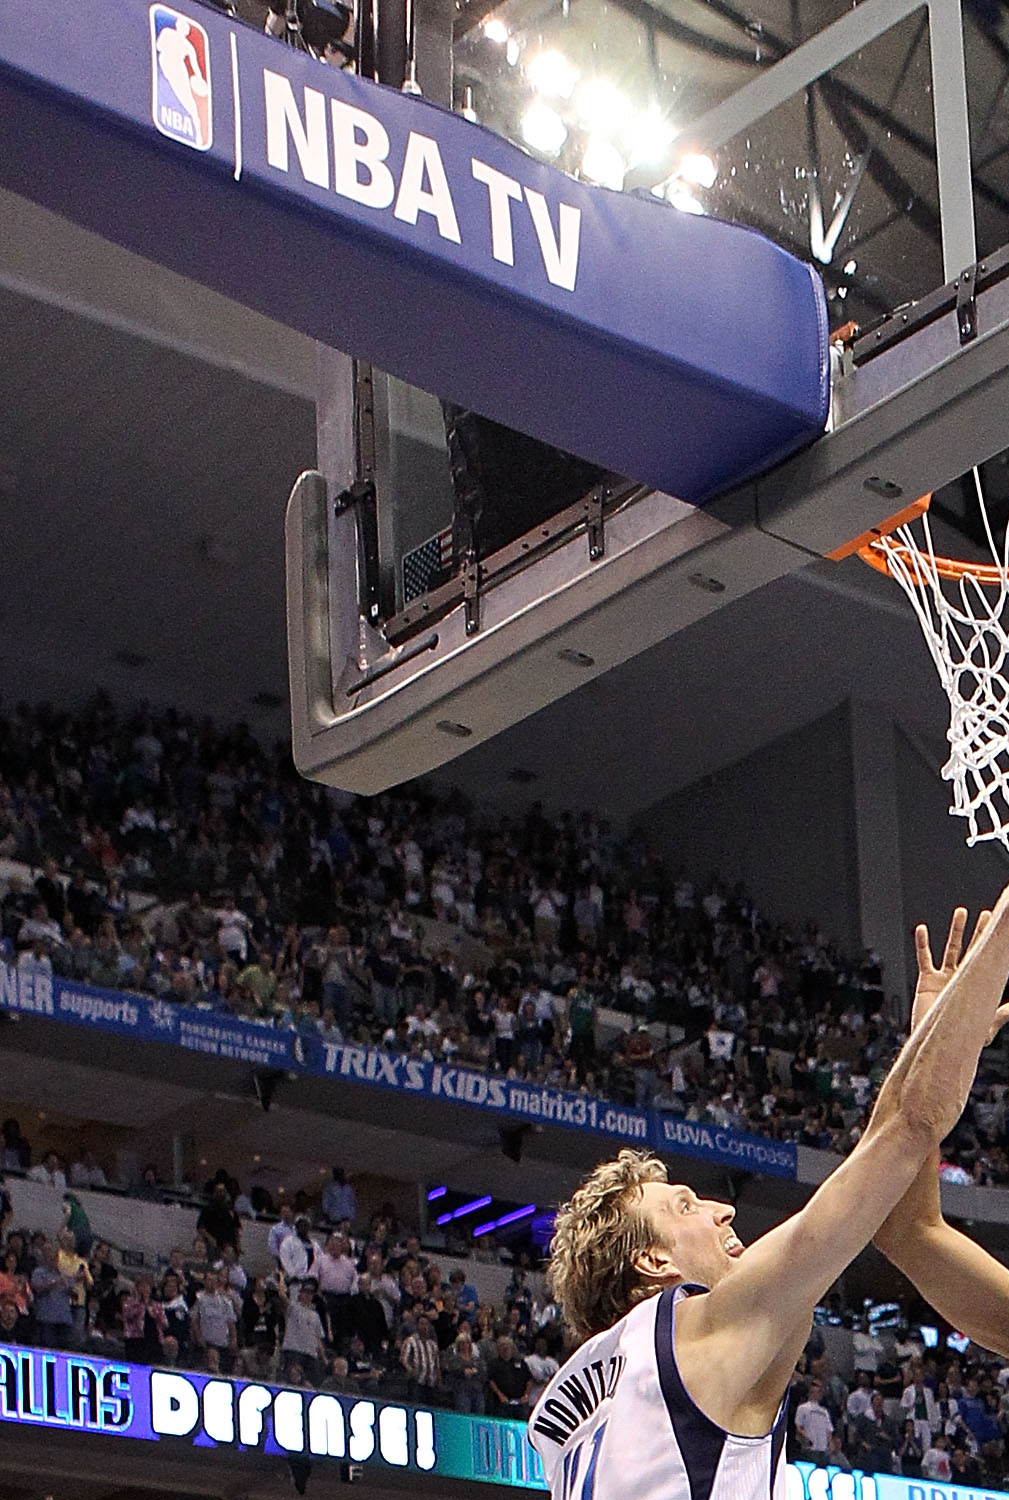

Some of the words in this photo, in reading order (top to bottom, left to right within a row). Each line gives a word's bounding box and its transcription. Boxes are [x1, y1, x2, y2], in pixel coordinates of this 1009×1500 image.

[161, 105, 194, 137] NBA
[263, 68, 461, 245] NBA
[471, 157, 581, 292] TV
[60, 990, 138, 1025] supports
[322, 1042, 424, 1091] TRIX'S
[431, 1066, 507, 1107] KIDS
[508, 1087, 646, 1139] matrix31.com
